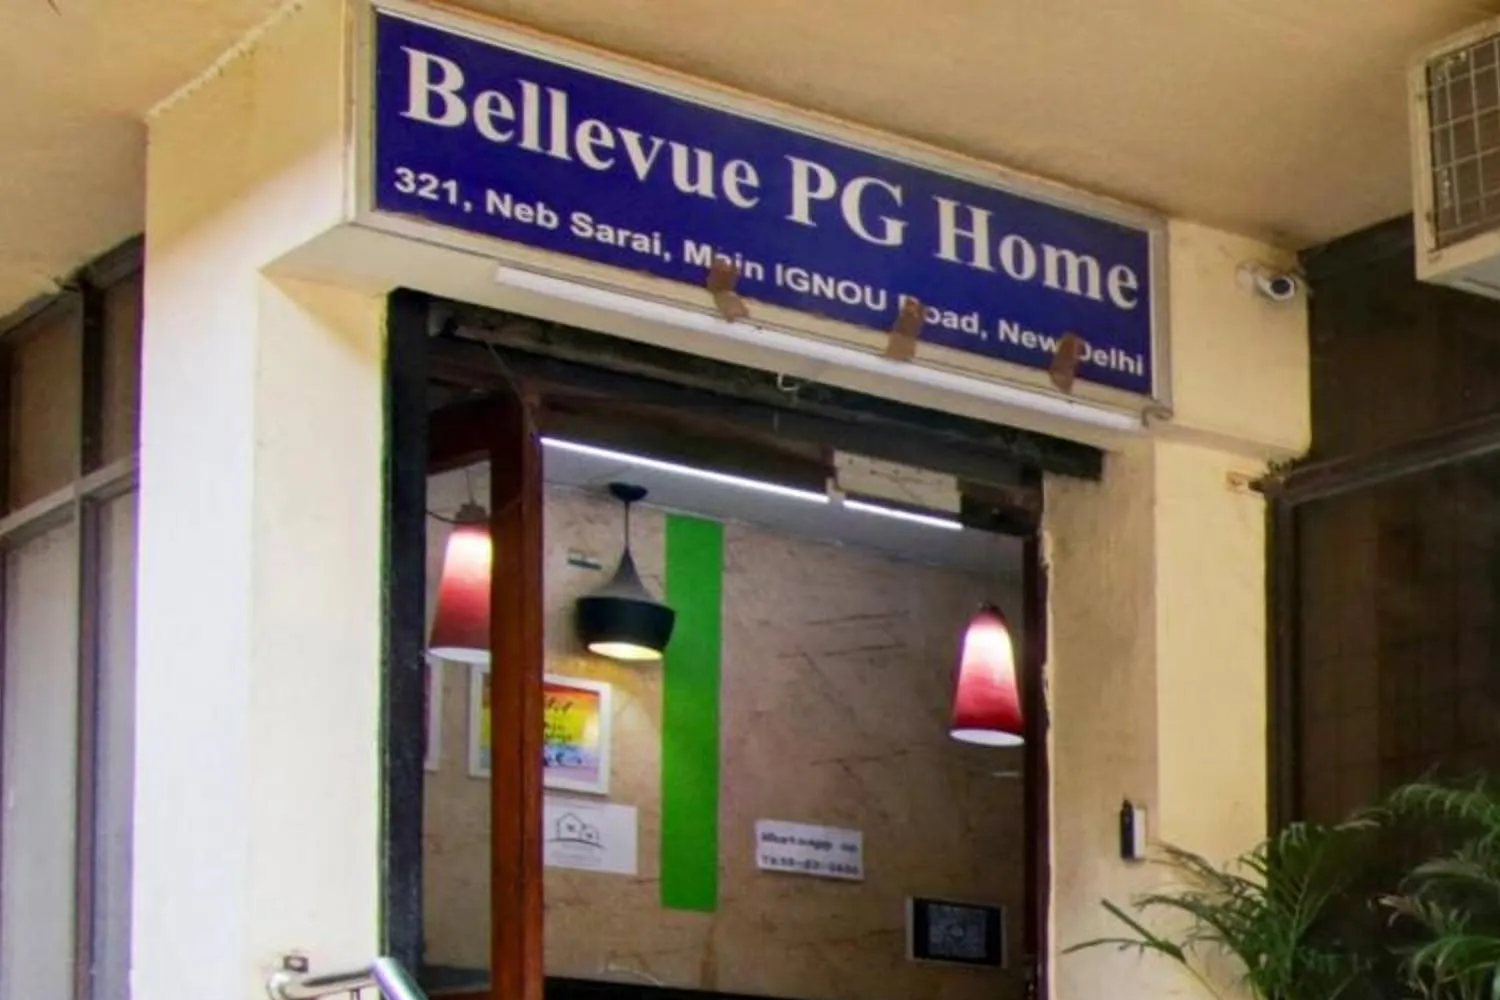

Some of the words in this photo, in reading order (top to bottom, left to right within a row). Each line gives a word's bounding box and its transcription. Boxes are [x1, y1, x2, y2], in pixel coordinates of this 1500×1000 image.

[394, 166, 473, 213] 321,
[485, 188, 560, 230] Neb
[570, 211, 672, 262] Sarai,
[776, 263, 888, 311] IGNOU
[998, 319, 1060, 355] New
[399, 46, 761, 209] Bellevue
[784, 154, 908, 247] PG
[931, 195, 1139, 311] Home
